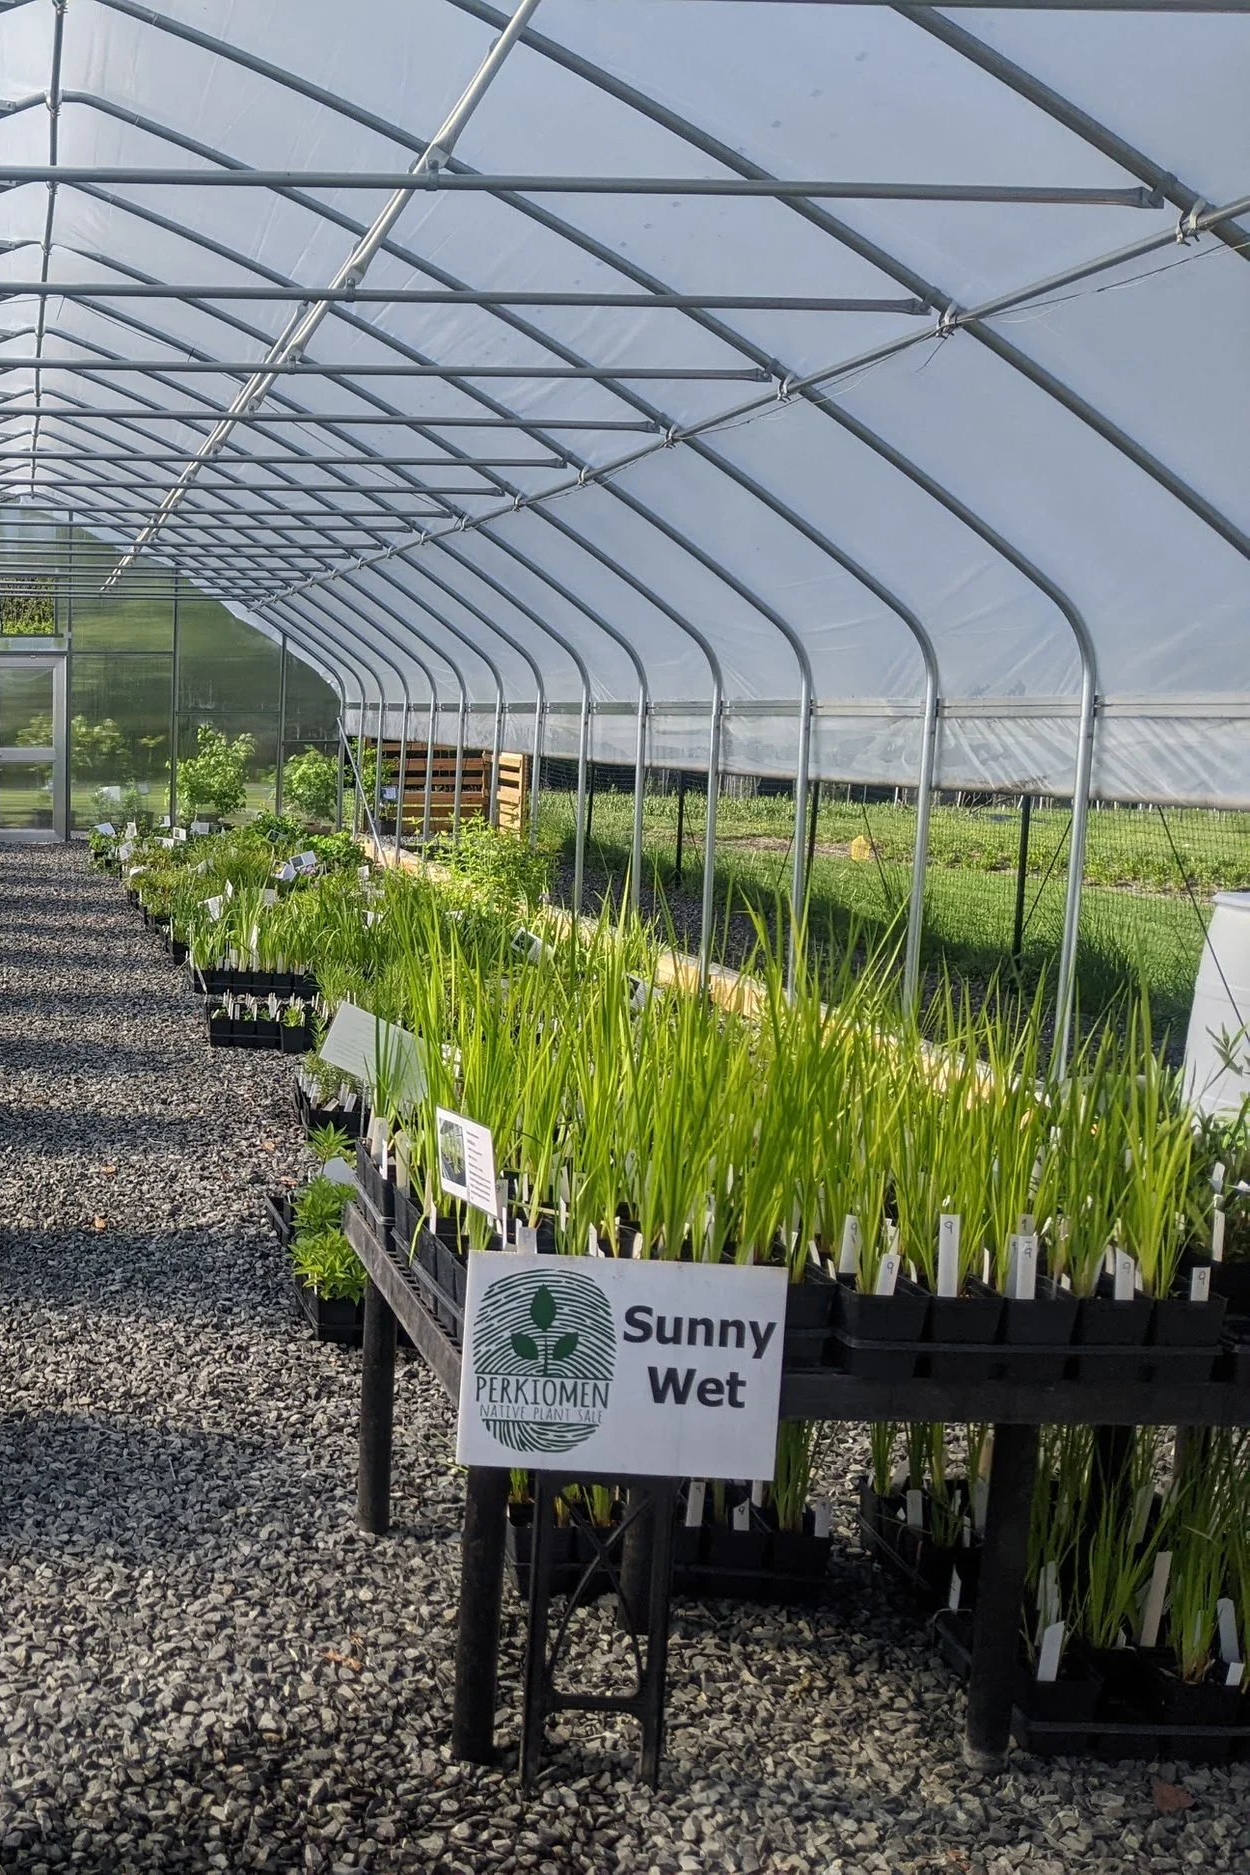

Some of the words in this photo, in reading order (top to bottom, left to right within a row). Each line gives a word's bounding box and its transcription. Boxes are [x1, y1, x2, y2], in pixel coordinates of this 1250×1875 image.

[944, 1220, 954, 1234] 9
[887, 1262, 894, 1274] 9
[1199, 1271, 1206, 1286] 9
[623, 1305, 777, 1359] Sunny
[475, 1375, 610, 1409] PERKIOMEN
[648, 1366, 746, 1408] Wet
[480, 1404, 525, 1420] NATIVE
[532, 1408, 570, 1422] PLANT
[578, 1410, 603, 1424] SALE
